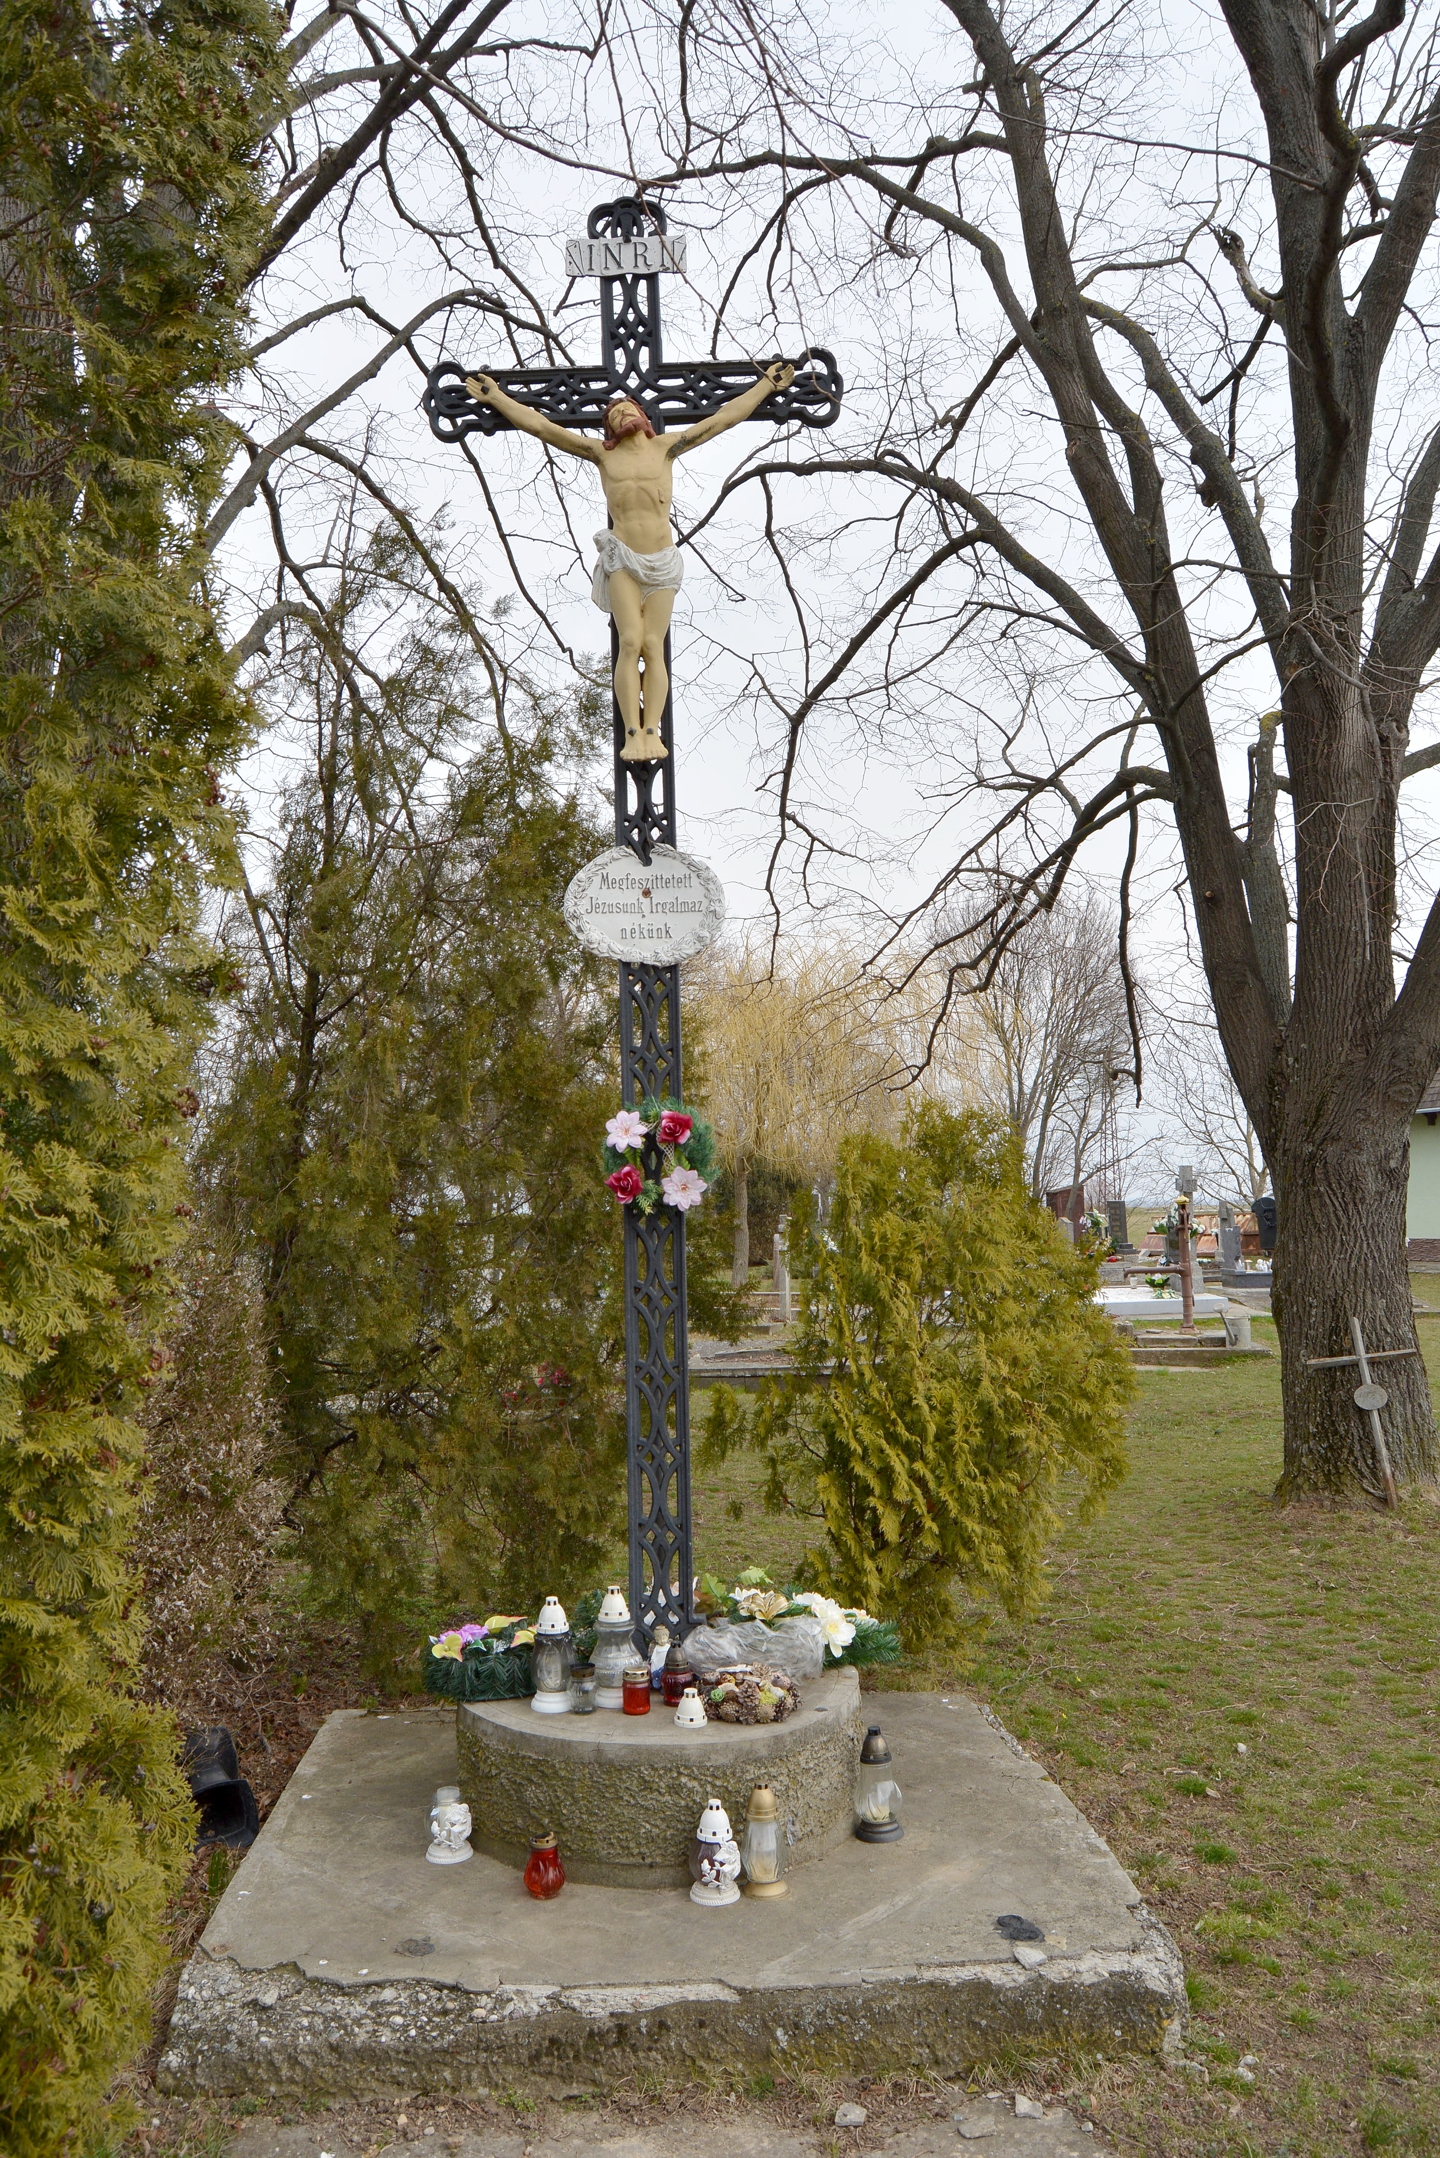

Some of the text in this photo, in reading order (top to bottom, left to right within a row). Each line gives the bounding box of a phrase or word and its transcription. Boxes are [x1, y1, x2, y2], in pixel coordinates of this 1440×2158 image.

[586, 896, 703, 915] Jézusunk Irgalmaz
[621, 922, 673, 939] nékünk
